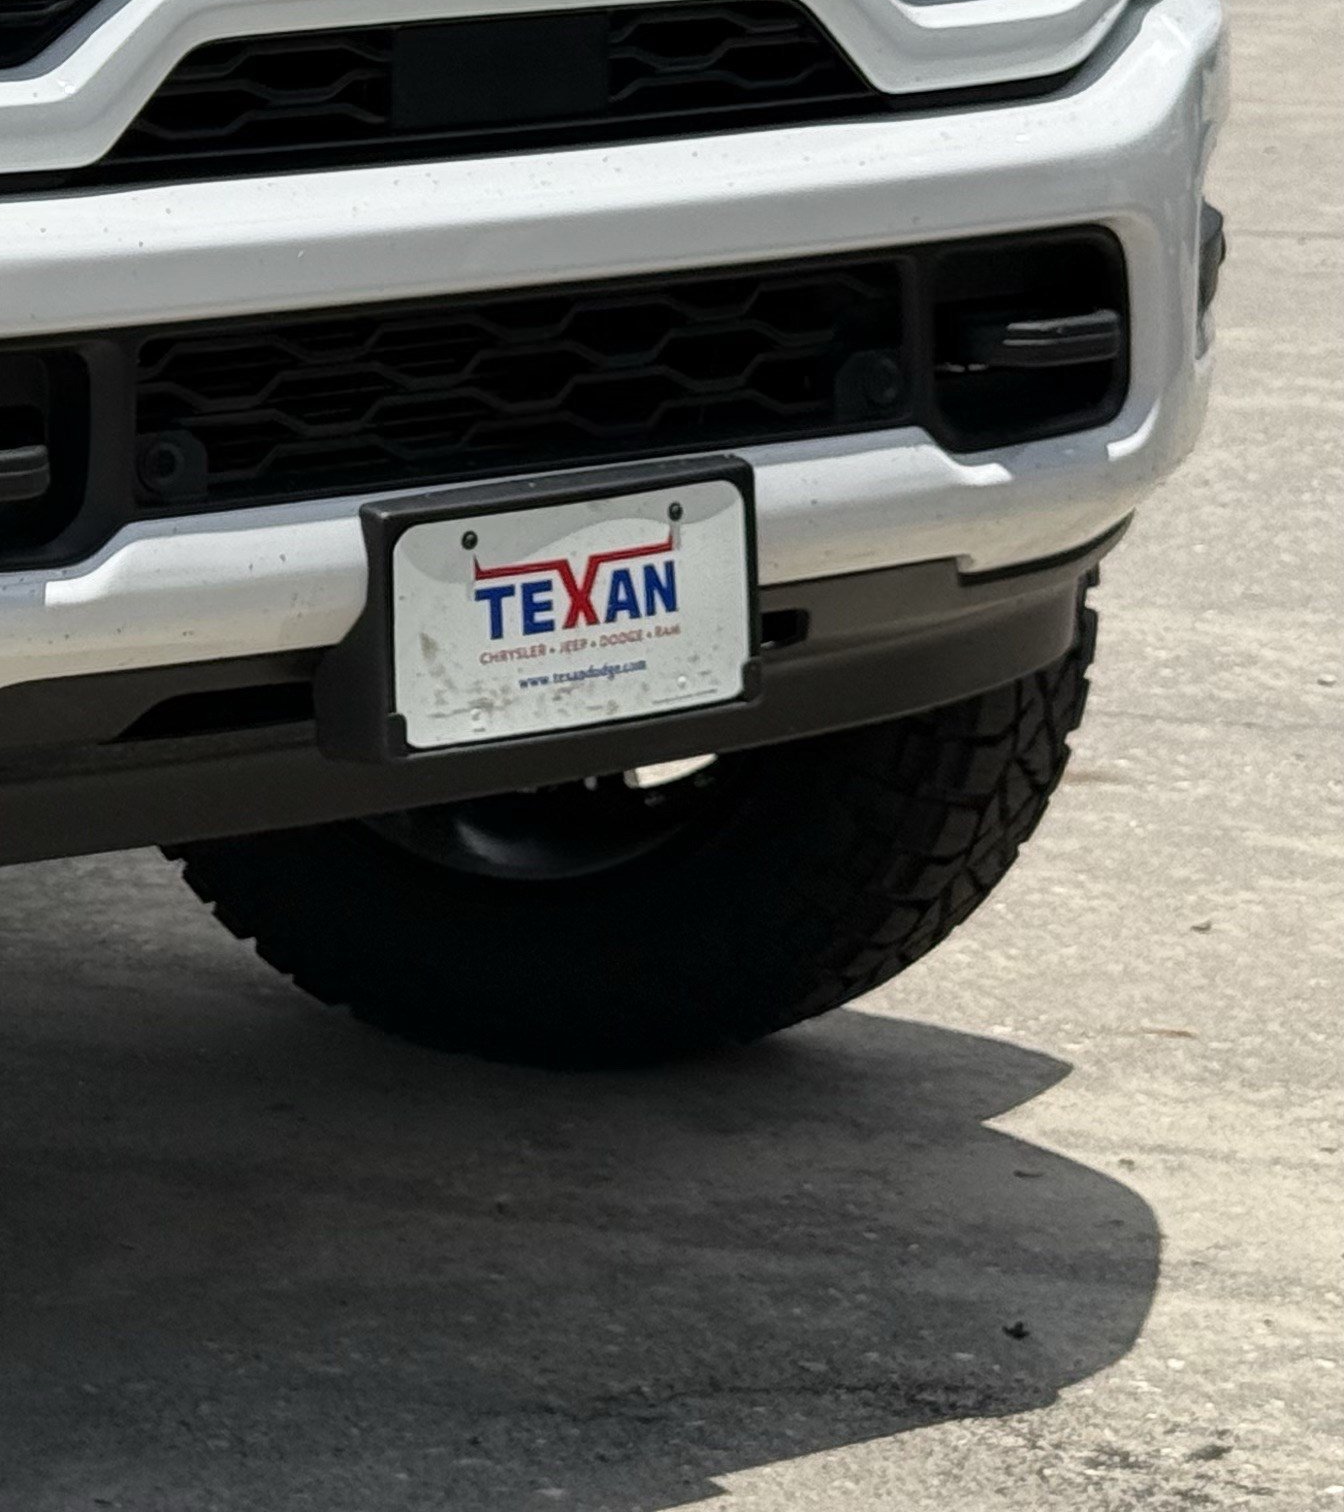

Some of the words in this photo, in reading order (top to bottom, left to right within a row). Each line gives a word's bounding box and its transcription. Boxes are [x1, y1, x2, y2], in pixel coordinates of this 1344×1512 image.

[473, 554, 678, 641] TEXAN
[479, 643, 547, 665] CHRYSLER
[559, 638, 588, 655] JEEP
[599, 629, 643, 647] DODGE
[655, 623, 682, 638] RAM
[518, 660, 647, 689] www.texandodge.com
